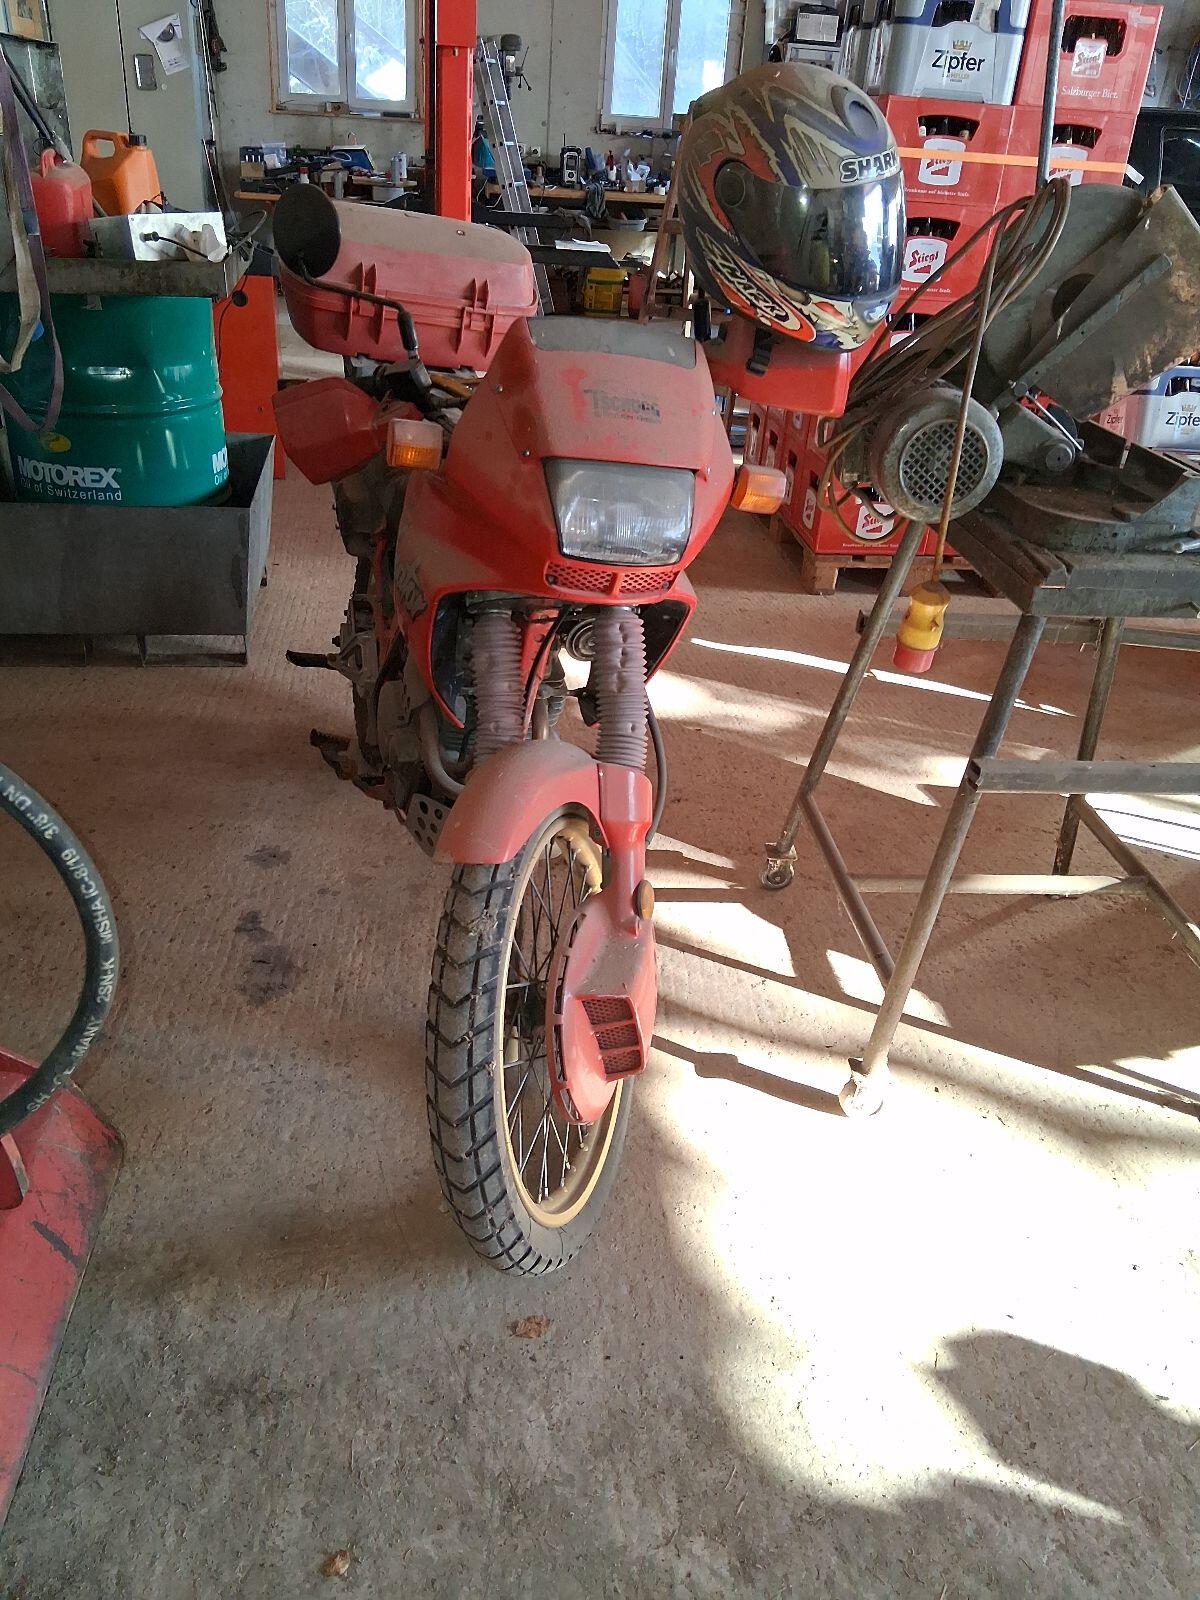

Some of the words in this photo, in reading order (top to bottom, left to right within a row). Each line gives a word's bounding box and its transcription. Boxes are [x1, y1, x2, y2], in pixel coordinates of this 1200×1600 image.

[931, 49, 986, 74] Zipfer
[1061, 85, 1101, 100] Salzburger
[908, 249, 939, 268] Stiegl
[17, 455, 120, 489] MOTOREX
[34, 482, 43, 493] of
[47, 486, 122, 501] Switzerland
[2, 785, 32, 811] DN
[61, 848, 99, 899] IC-8/19
[91, 896, 114, 945] MSHA
[97, 956, 115, 1003] 2SN-K
